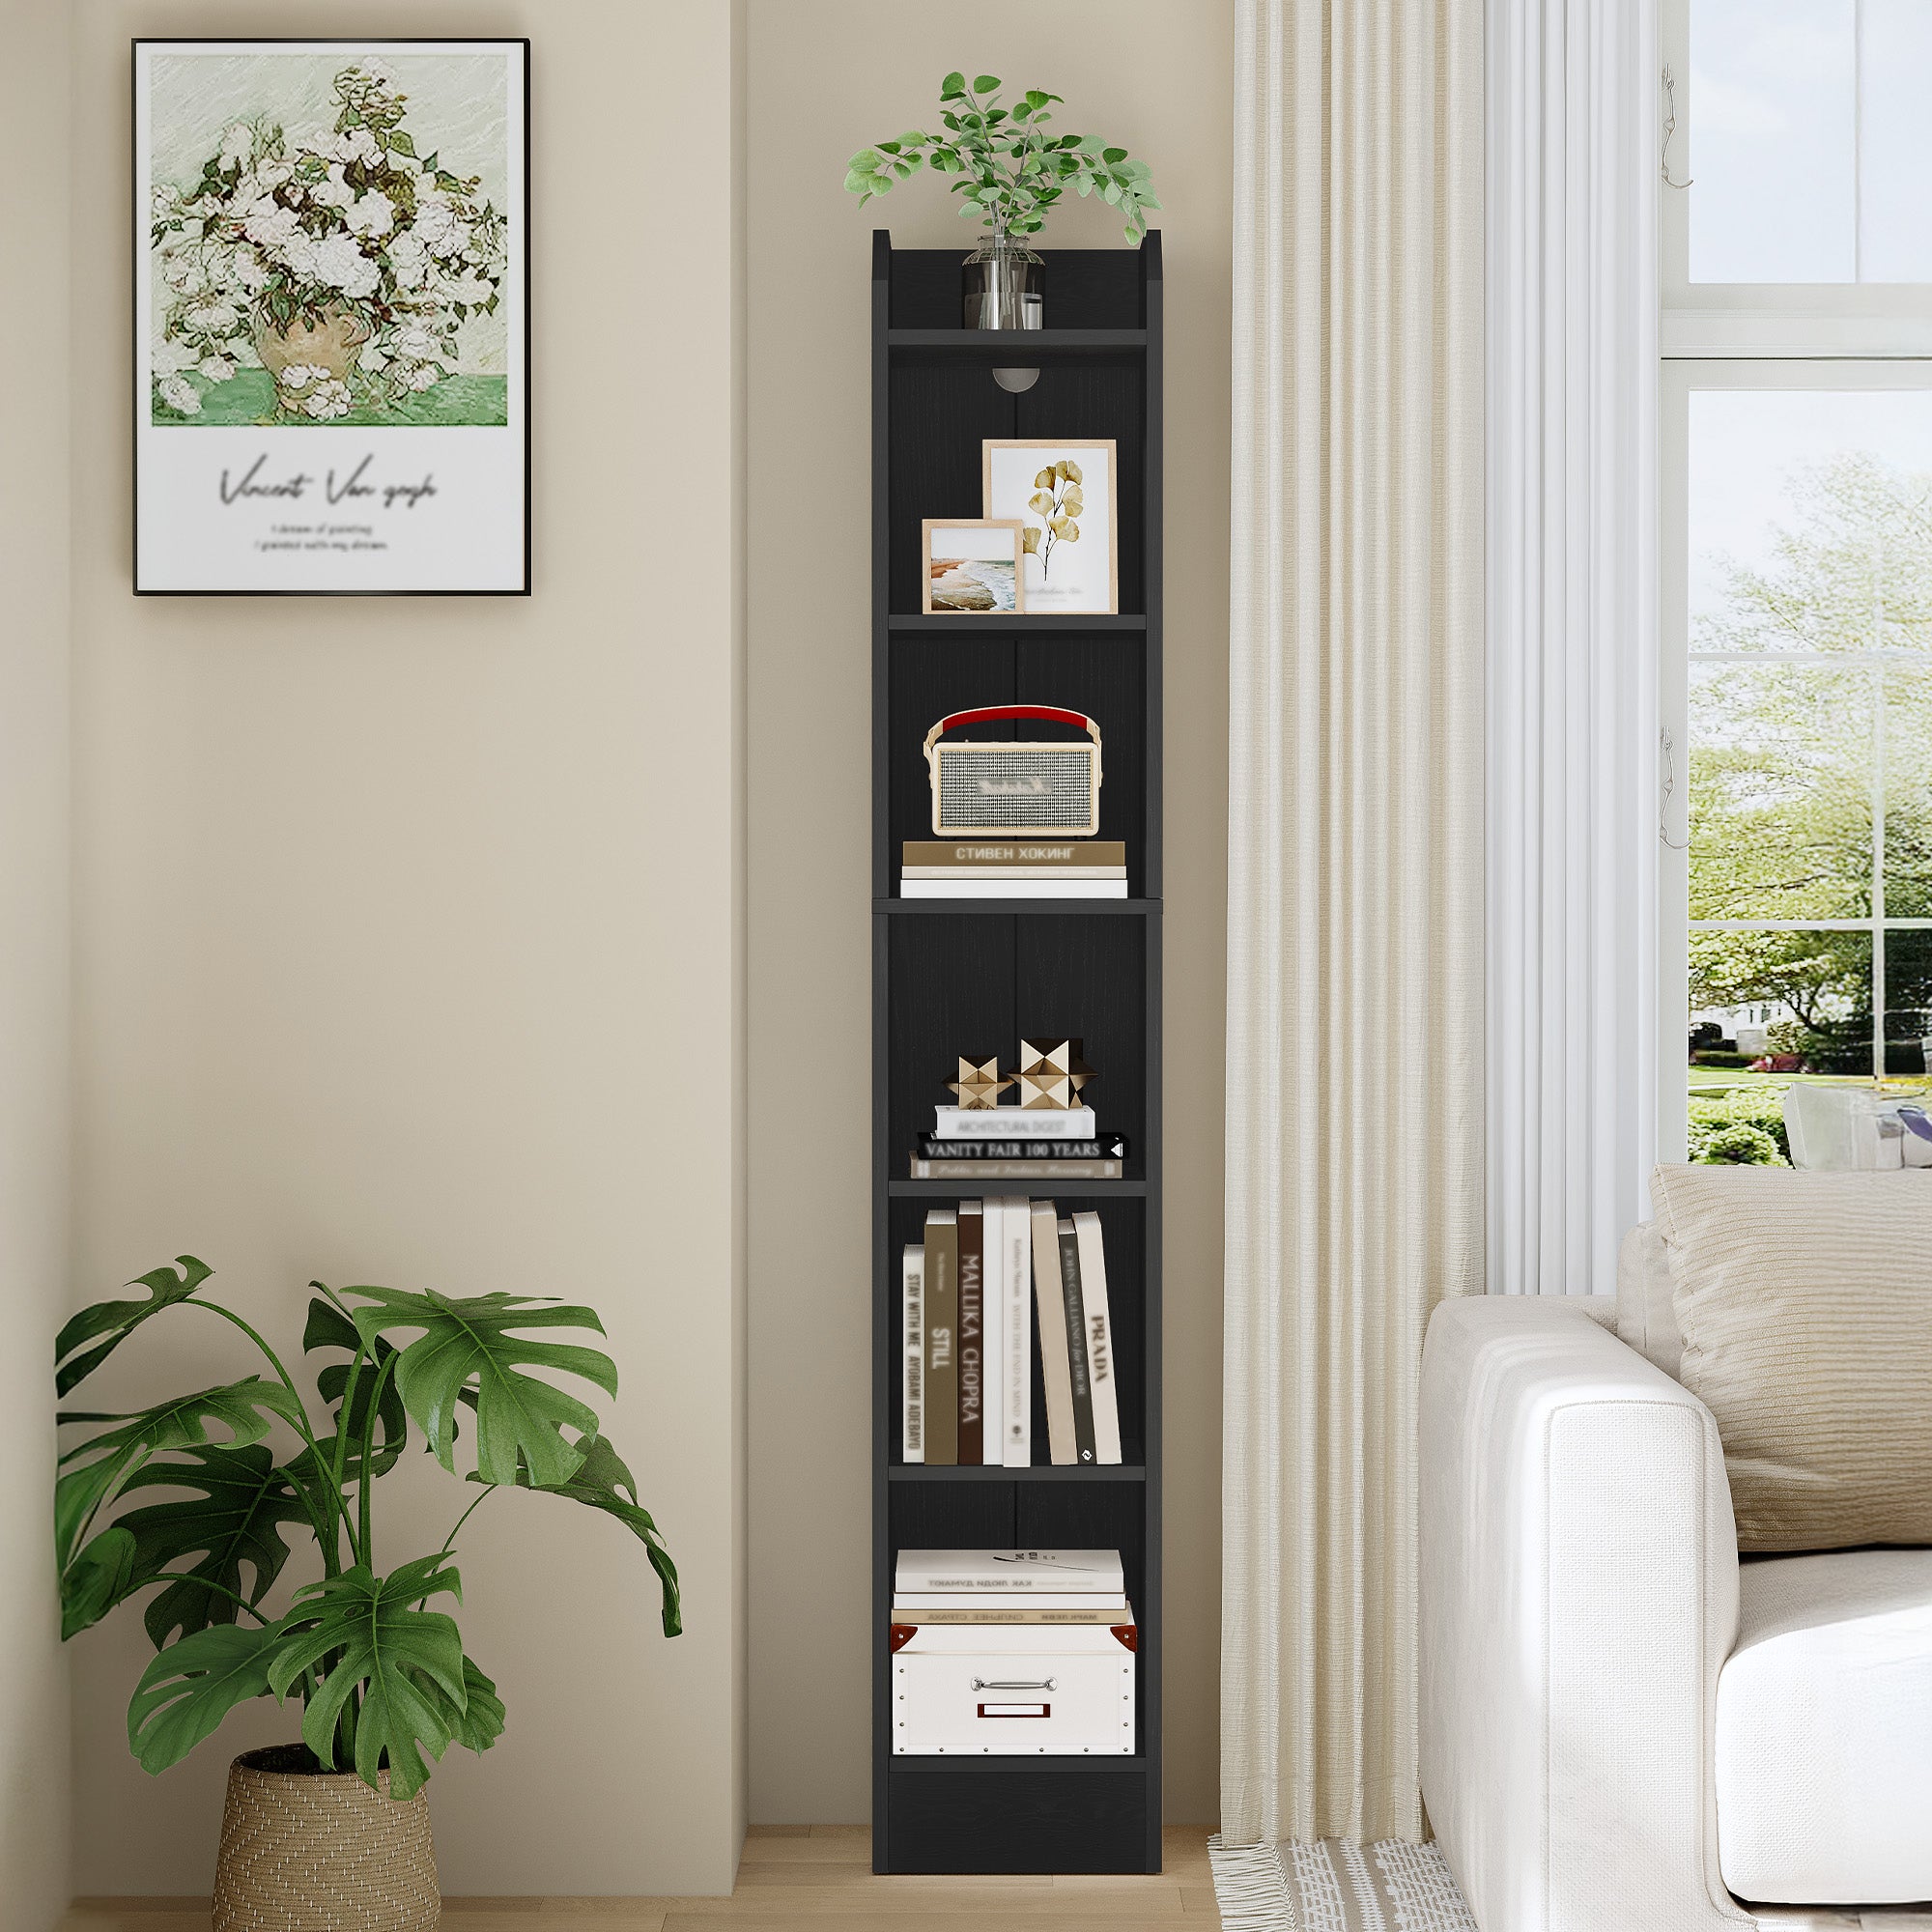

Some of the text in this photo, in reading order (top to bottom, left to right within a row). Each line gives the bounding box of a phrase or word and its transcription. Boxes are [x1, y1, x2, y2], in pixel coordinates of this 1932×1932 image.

[220, 453, 314, 505] Vincent
[327, 453, 375, 505] Van
[955, 847, 1075, 860] СТИВЕН ХОКИНГ
[957, 1120, 1029, 1133] ARCHITECTURAL
[924, 1143, 1100, 1157] VANITY FAIR 100 YEARS
[977, 1163, 998, 1176] and
[1065, 1248, 1076, 1281] JOHN
[908, 1274, 921, 1347] STAY WITH ME
[1067, 1283, 1082, 1346] GALLIANO
[932, 1328, 951, 1370] STILL
[962, 1256, 980, 1423] MALLIKA CHOPRA
[1091, 1316, 1108, 1383] PRADA
[1074, 1365, 1086, 1396] DIOR
